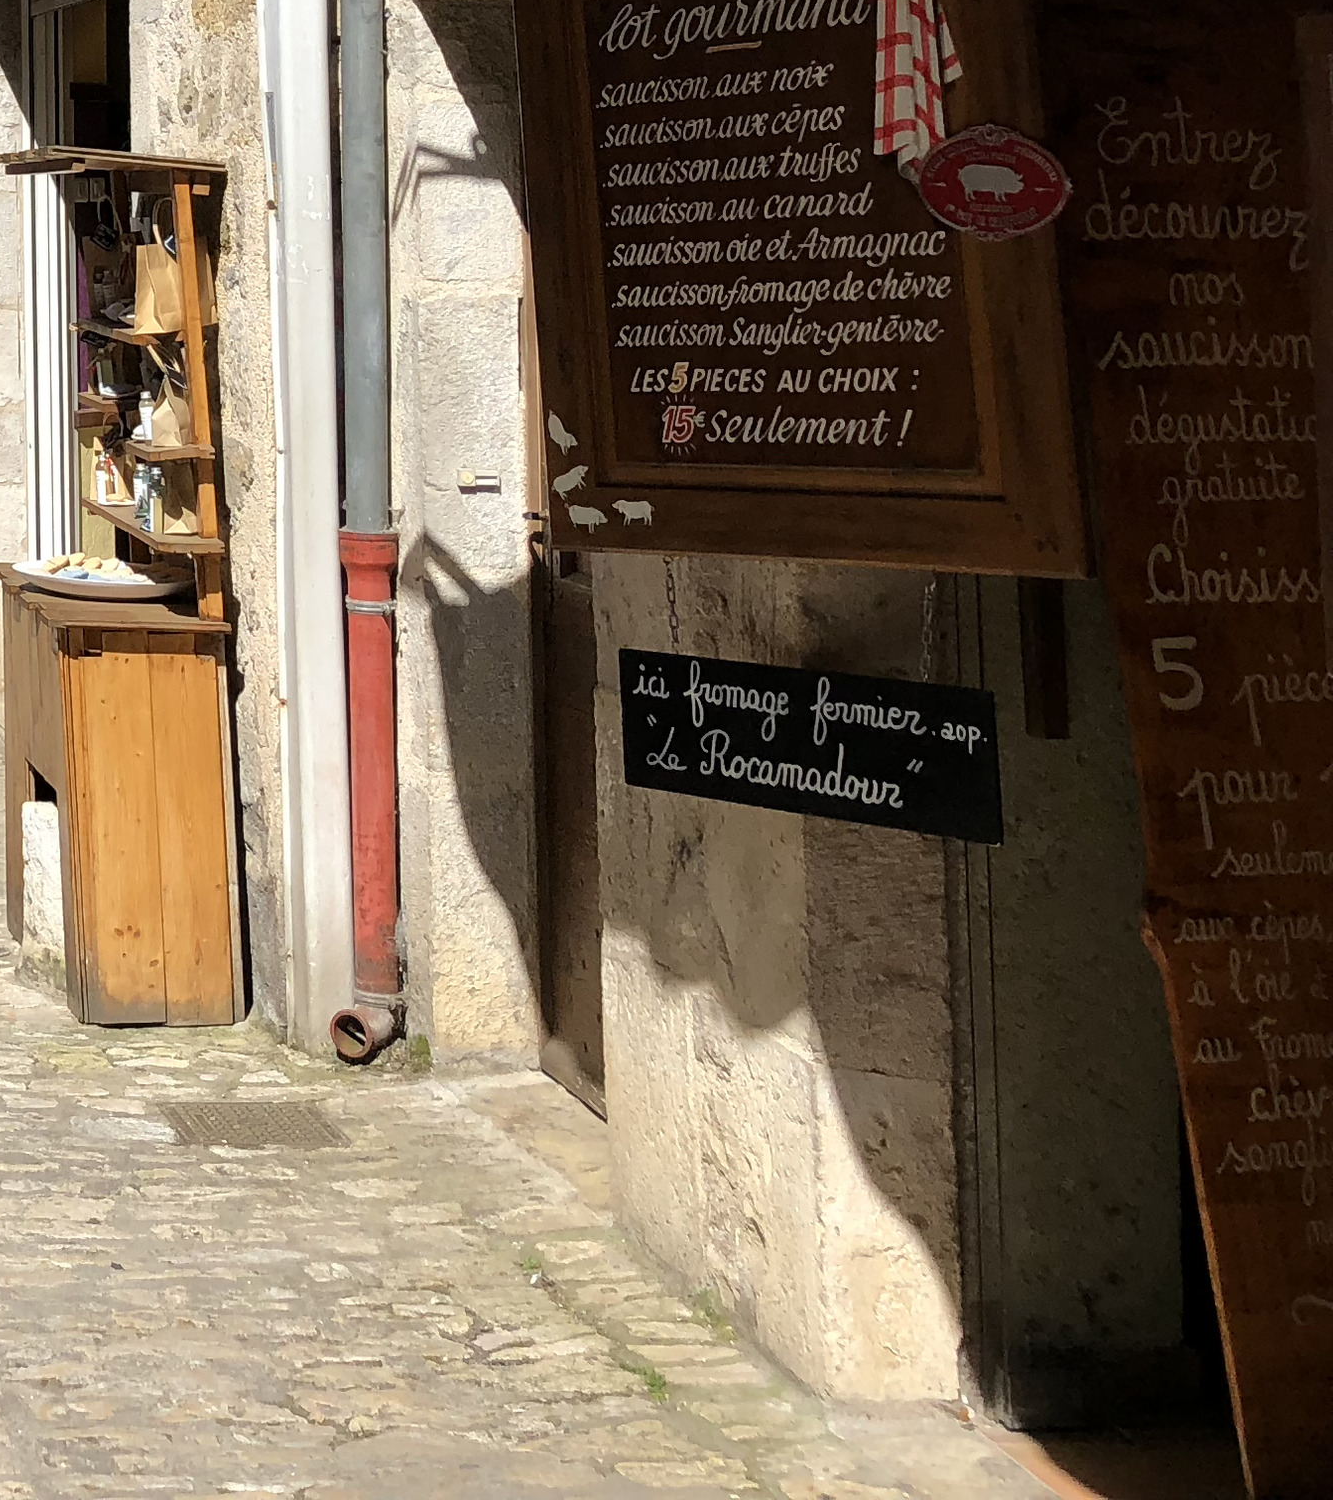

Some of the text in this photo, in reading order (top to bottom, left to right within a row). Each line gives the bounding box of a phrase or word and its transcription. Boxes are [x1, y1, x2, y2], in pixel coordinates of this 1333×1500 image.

[599, 3, 661, 53] lot
[712, 69, 768, 98] aux
[769, 59, 835, 93] noix
[716, 113, 769, 140] aux
[1093, 94, 1283, 191] Entrez
[719, 153, 775, 183] aux
[776, 143, 862, 183] truffes
[717, 197, 761, 222] au
[763, 180, 874, 220] canard
[1082, 166, 1310, 273] découvrez
[725, 232, 763, 263] oie
[765, 229, 793, 262] et
[791, 226, 947, 268] Armagnac
[720, 275, 832, 313] fromage
[832, 269, 865, 302] de
[1168, 271, 1245, 308] nos
[630, 367, 669, 394] LES
[667, 360, 690, 394] 5
[689, 367, 767, 393] PIECES
[776, 367, 812, 394] AU
[817, 366, 899, 394] CHOIX
[704, 404, 892, 448] Seulement
[1156, 450, 1306, 549] gratuite
[1150, 634, 1205, 712] 5
[632, 663, 671, 700] ici
[683, 659, 791, 743] fromage
[809, 675, 928, 747] fermier
[1176, 766, 1299, 851] pour
[1186, 961, 1218, 1008] à
[1192, 1036, 1243, 1065] au
